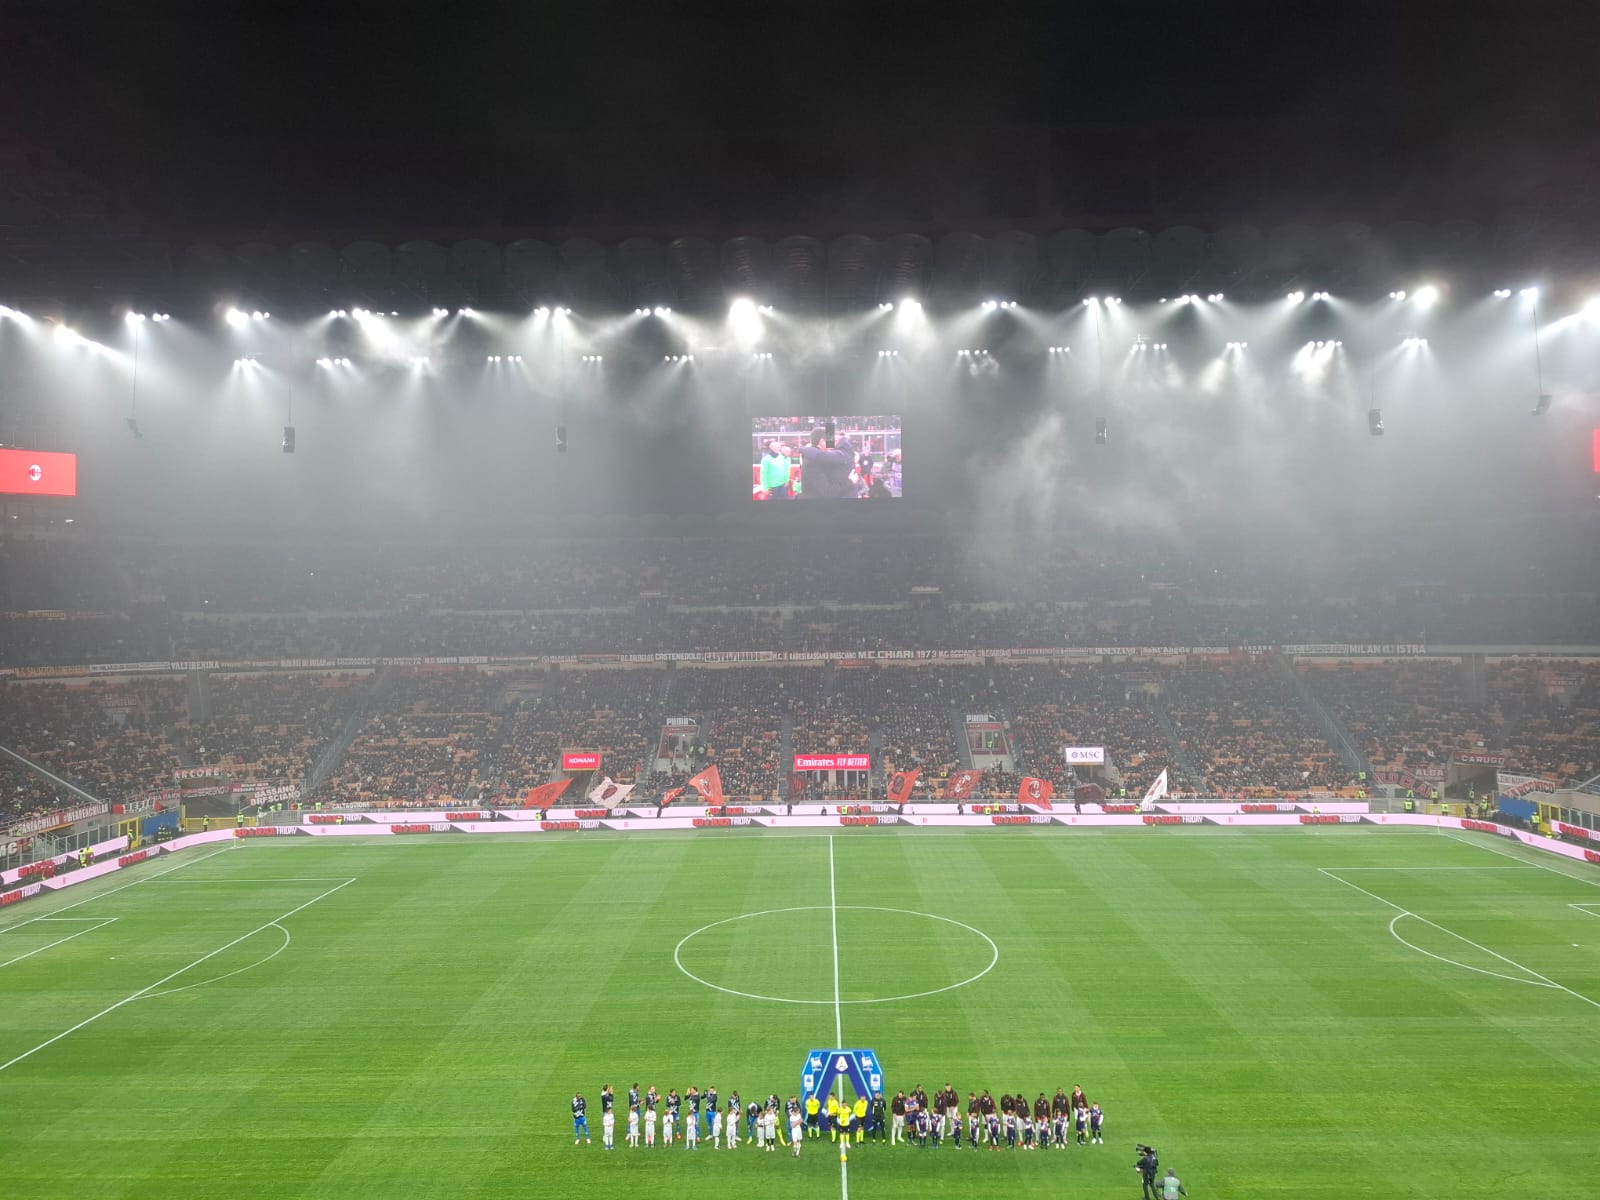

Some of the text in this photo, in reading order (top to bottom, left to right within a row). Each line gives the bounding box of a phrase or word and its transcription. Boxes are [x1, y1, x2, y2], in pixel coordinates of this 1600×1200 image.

[1350, 644, 1380, 653] MILAN
[1397, 644, 1425, 653] ISTRA
[877, 650, 914, 659] CHIARI
[918, 650, 937, 658] 1973
[966, 714, 989, 722] PUMA
[1080, 751, 1100, 759] MSC
[797, 758, 867, 767] Emirates FLY BETTER
